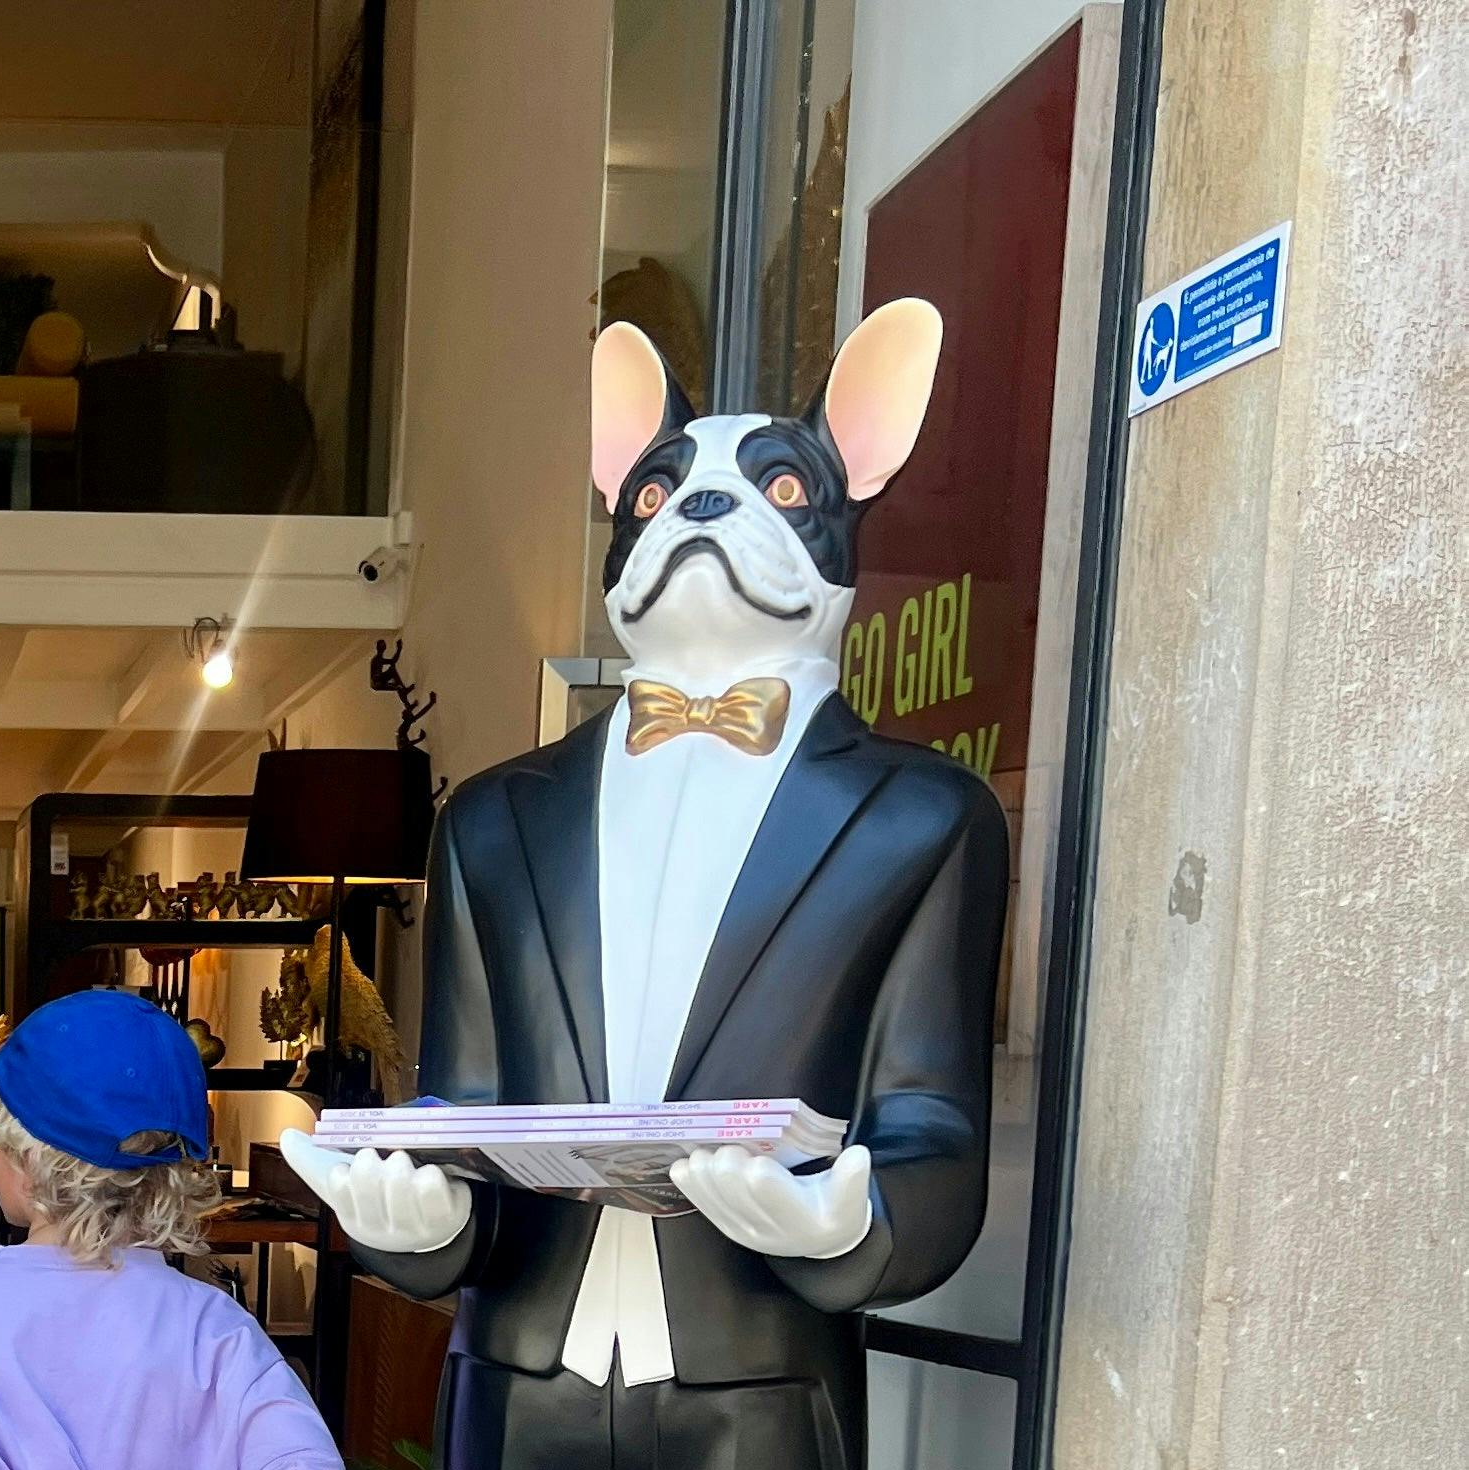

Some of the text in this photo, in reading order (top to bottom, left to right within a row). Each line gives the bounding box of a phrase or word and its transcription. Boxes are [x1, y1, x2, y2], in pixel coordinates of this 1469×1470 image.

[841, 573, 973, 725] GO GIRL
[676, 1103, 701, 1111] SHOP
[733, 1101, 769, 1109] KARE
[668, 1118, 693, 1126] SHOP
[725, 1117, 761, 1125] KARE
[662, 1130, 686, 1138] SHOP
[717, 1130, 753, 1138] KARE
